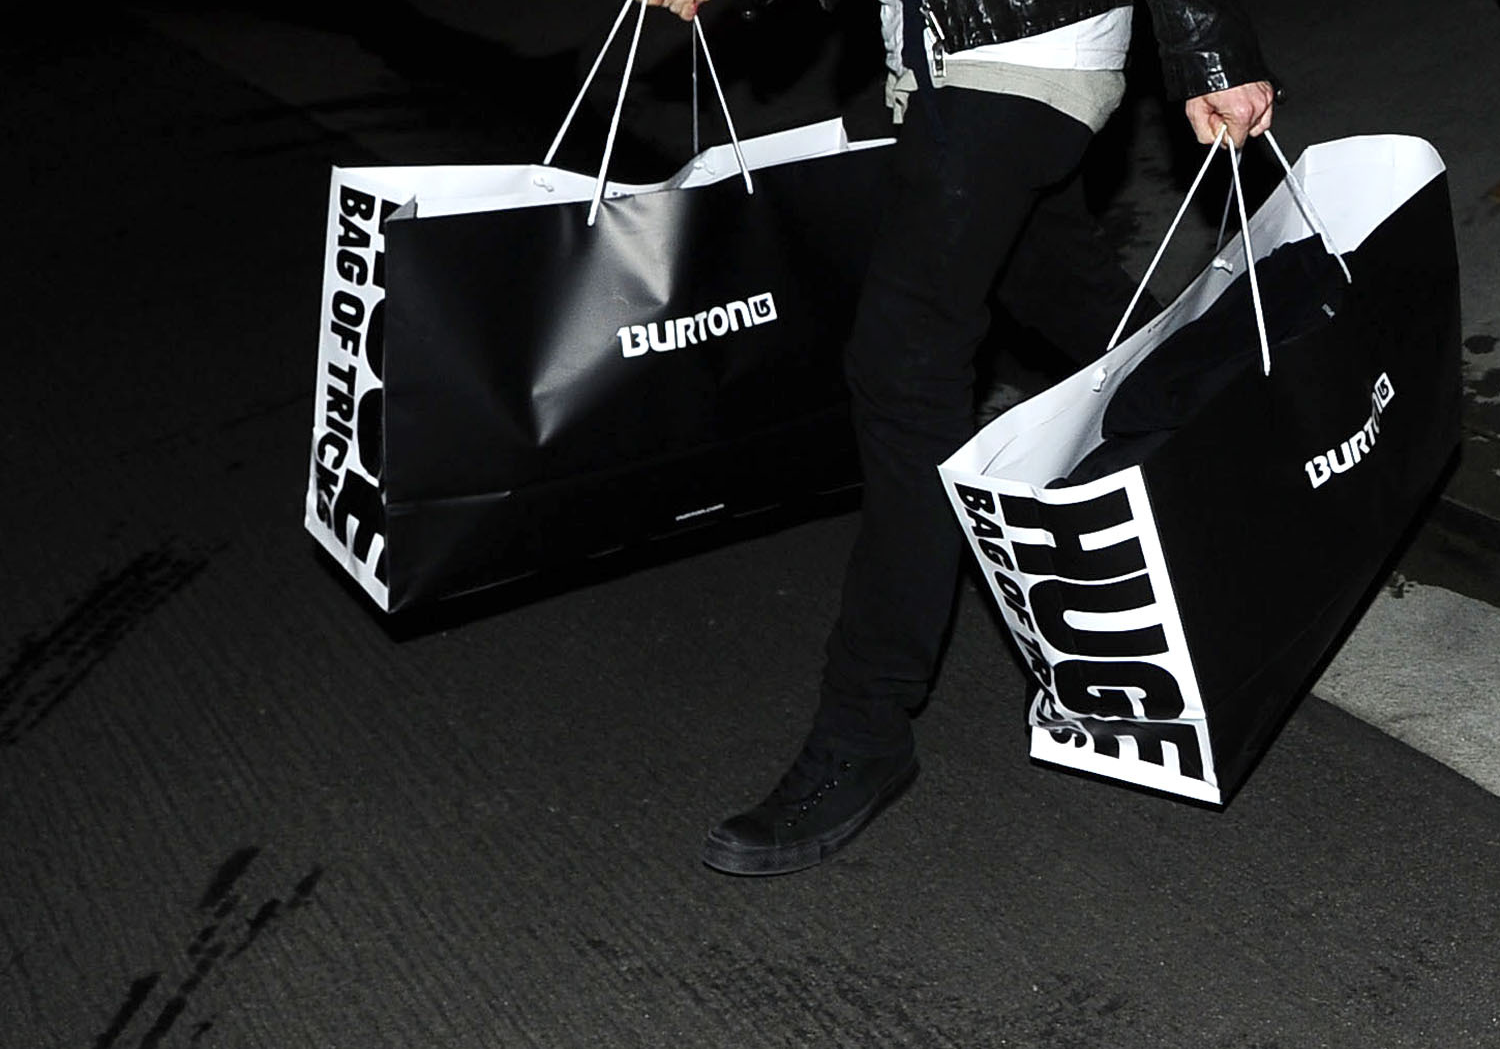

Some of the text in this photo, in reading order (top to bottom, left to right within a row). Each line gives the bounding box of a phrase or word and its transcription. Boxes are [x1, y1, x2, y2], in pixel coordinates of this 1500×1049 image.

[336, 184, 377, 286] BAG
[330, 290, 366, 358] OF
[616, 300, 753, 359] BURTON
[953, 482, 1015, 572] BAG
[994, 570, 1037, 634] OF
[998, 486, 1205, 782] HUGE
